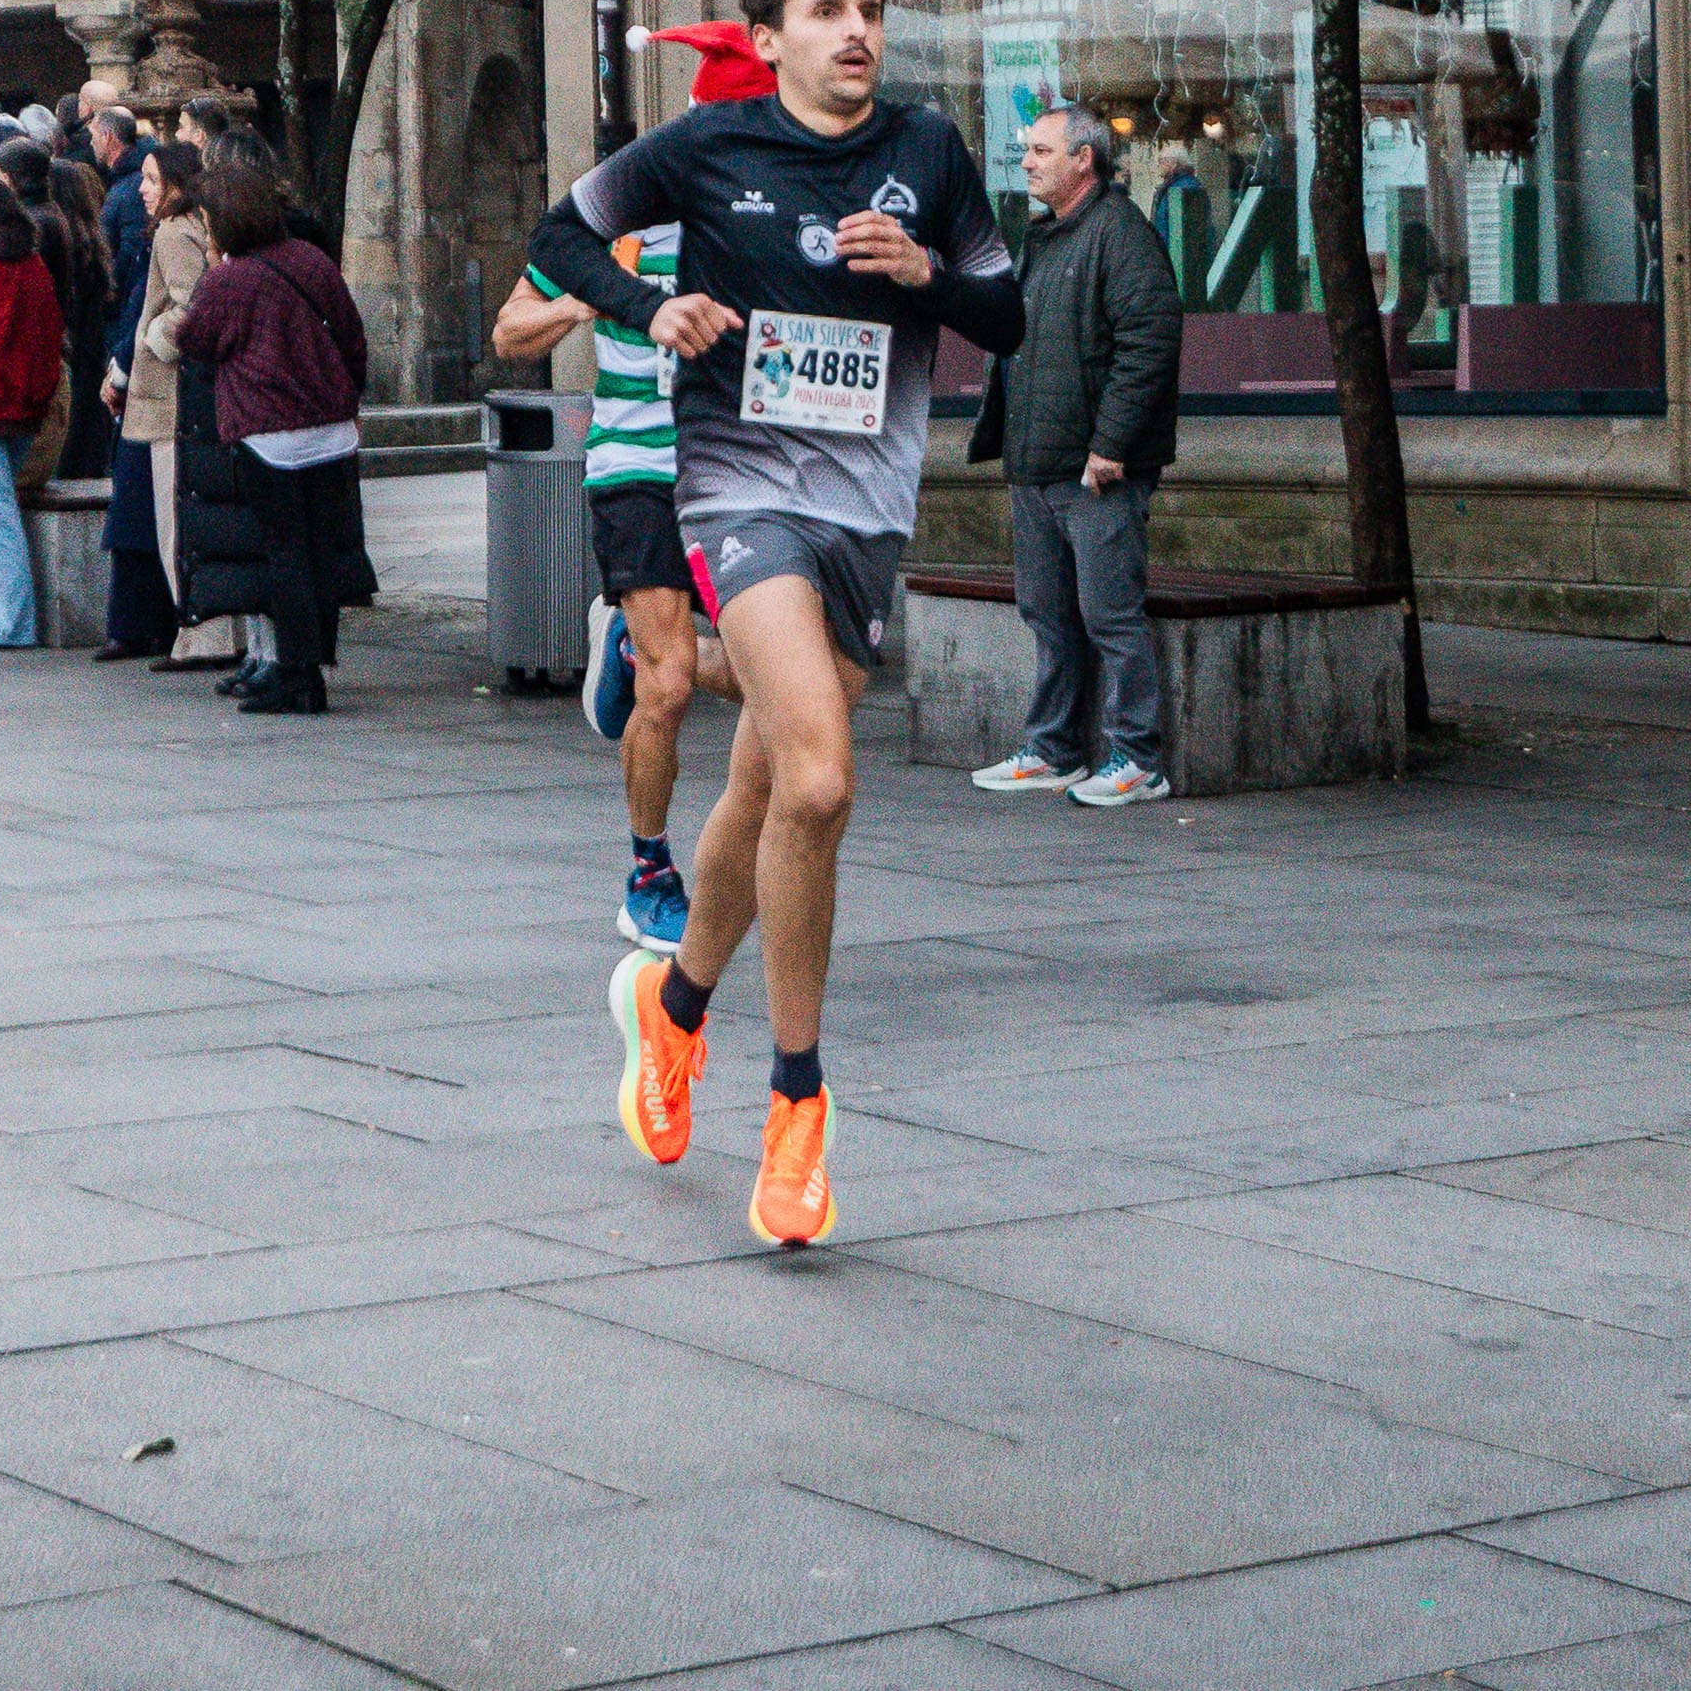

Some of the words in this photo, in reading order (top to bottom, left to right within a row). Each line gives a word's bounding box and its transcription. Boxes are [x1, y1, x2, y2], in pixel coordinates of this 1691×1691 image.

[731, 199, 775, 214] amura
[788, 319, 816, 344] SAN
[820, 323, 882, 351] SILVESRE
[796, 347, 880, 390] 4885
[794, 387, 852, 408] PONTEVEDRA
[855, 394, 877, 410] 2025
